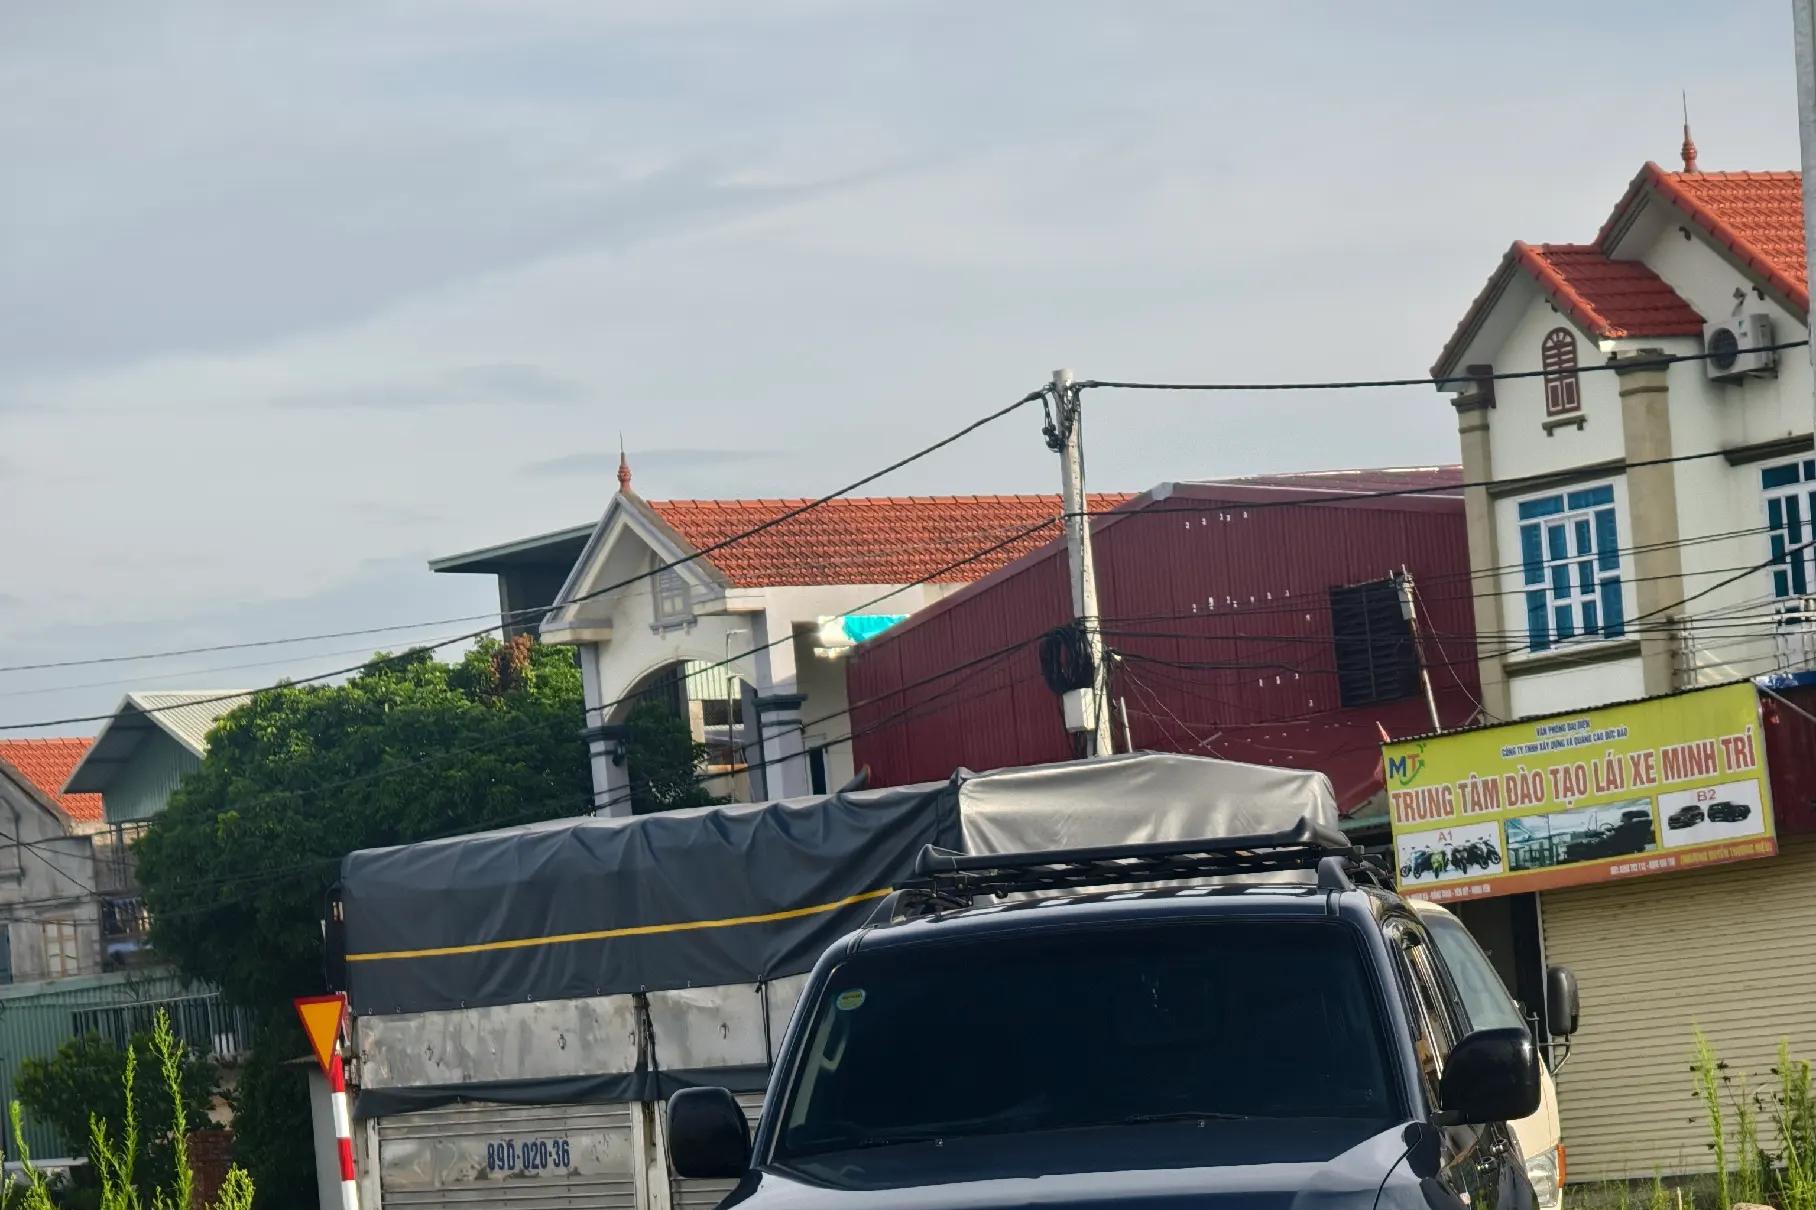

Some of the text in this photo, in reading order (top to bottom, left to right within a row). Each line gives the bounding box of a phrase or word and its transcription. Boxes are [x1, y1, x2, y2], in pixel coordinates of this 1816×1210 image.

[1391, 726, 1756, 823] TRUNG TÂM ĐÀO TẠO LÁI XE MINH TRÍ
[1697, 788, 1717, 802] B2
[1438, 830, 1453, 842] A1
